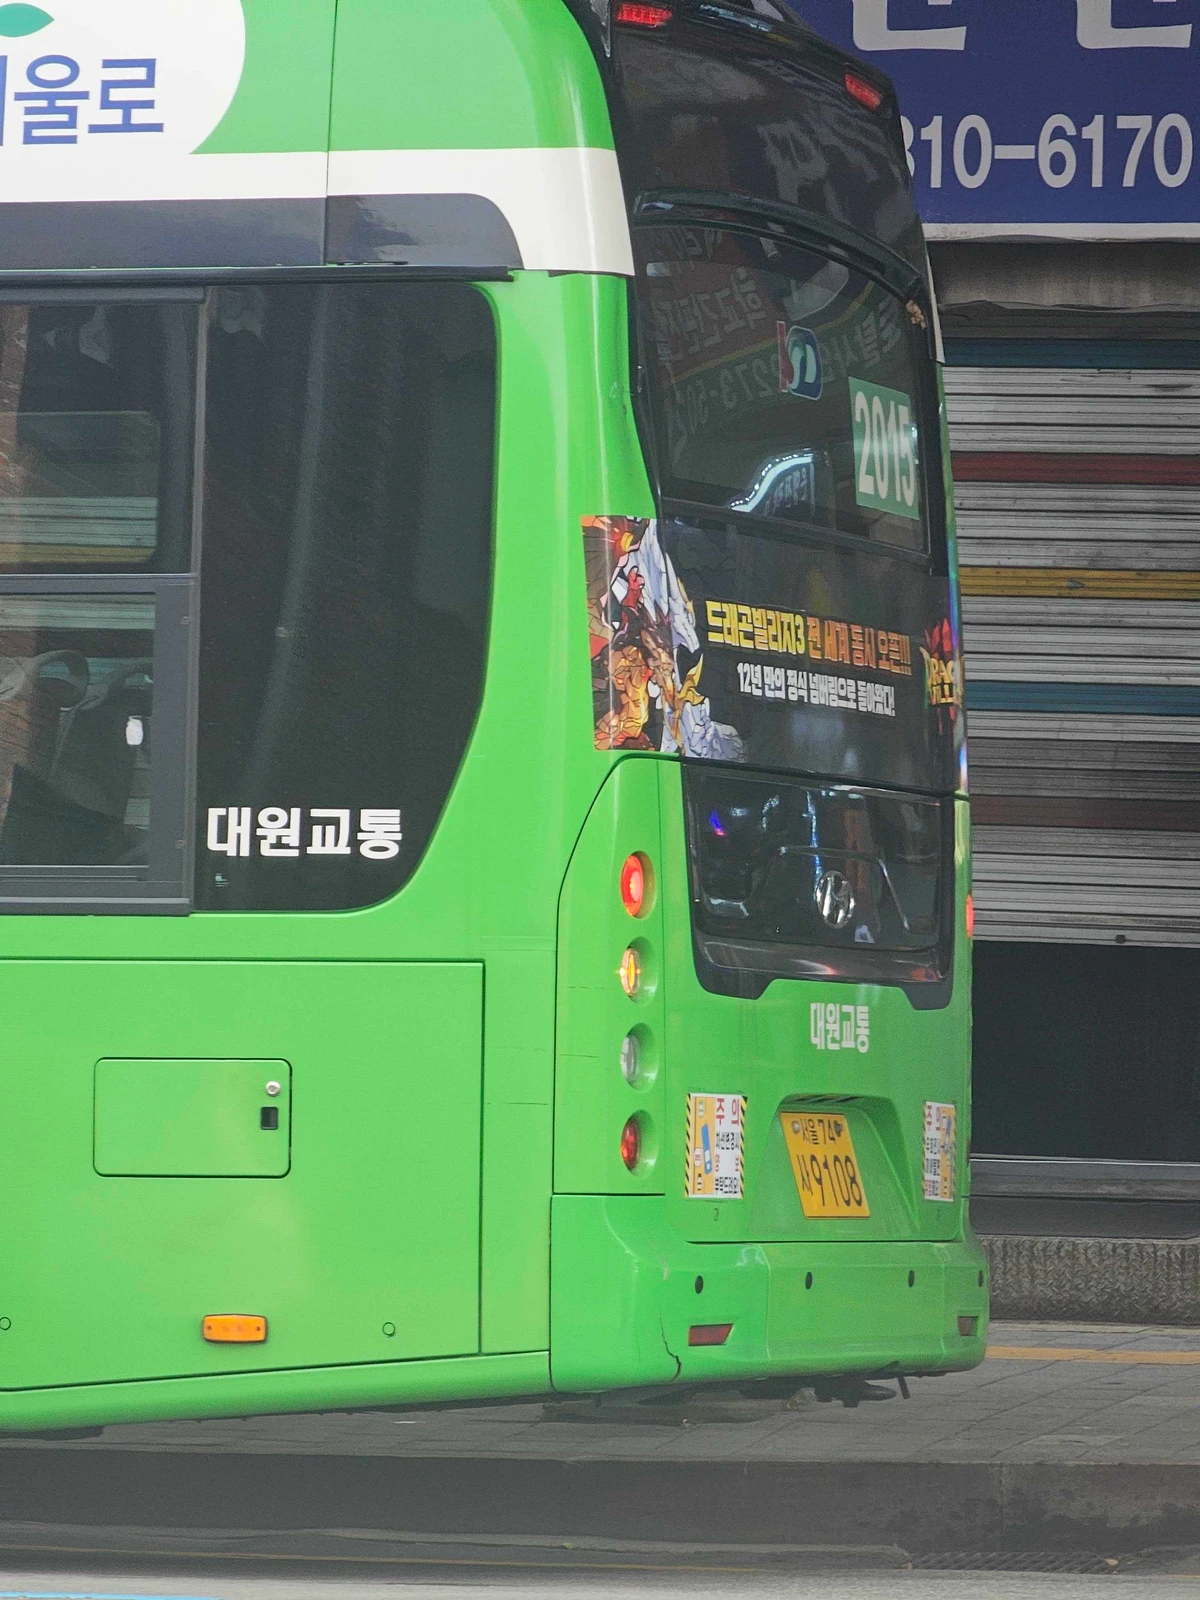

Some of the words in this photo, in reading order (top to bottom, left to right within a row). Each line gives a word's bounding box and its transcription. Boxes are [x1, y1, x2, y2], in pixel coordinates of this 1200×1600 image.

[0, 54, 164, 146] 울로
[855, 391, 915, 507] 2015
[705, 600, 805, 655] 드래곤빌리지3
[806, 616, 822, 659] 전
[824, 620, 850, 664] 세계
[850, 624, 876, 668] 동시
[737, 662, 762, 696] 12년
[763, 665, 786, 699] 만의
[787, 669, 808, 702] 정식
[809, 672, 857, 709] 넘버링으로
[207, 806, 402, 859] 대원교통
[810, 1002, 870, 1053] 대원교통
[796, 1153, 863, 1208] 사9108
